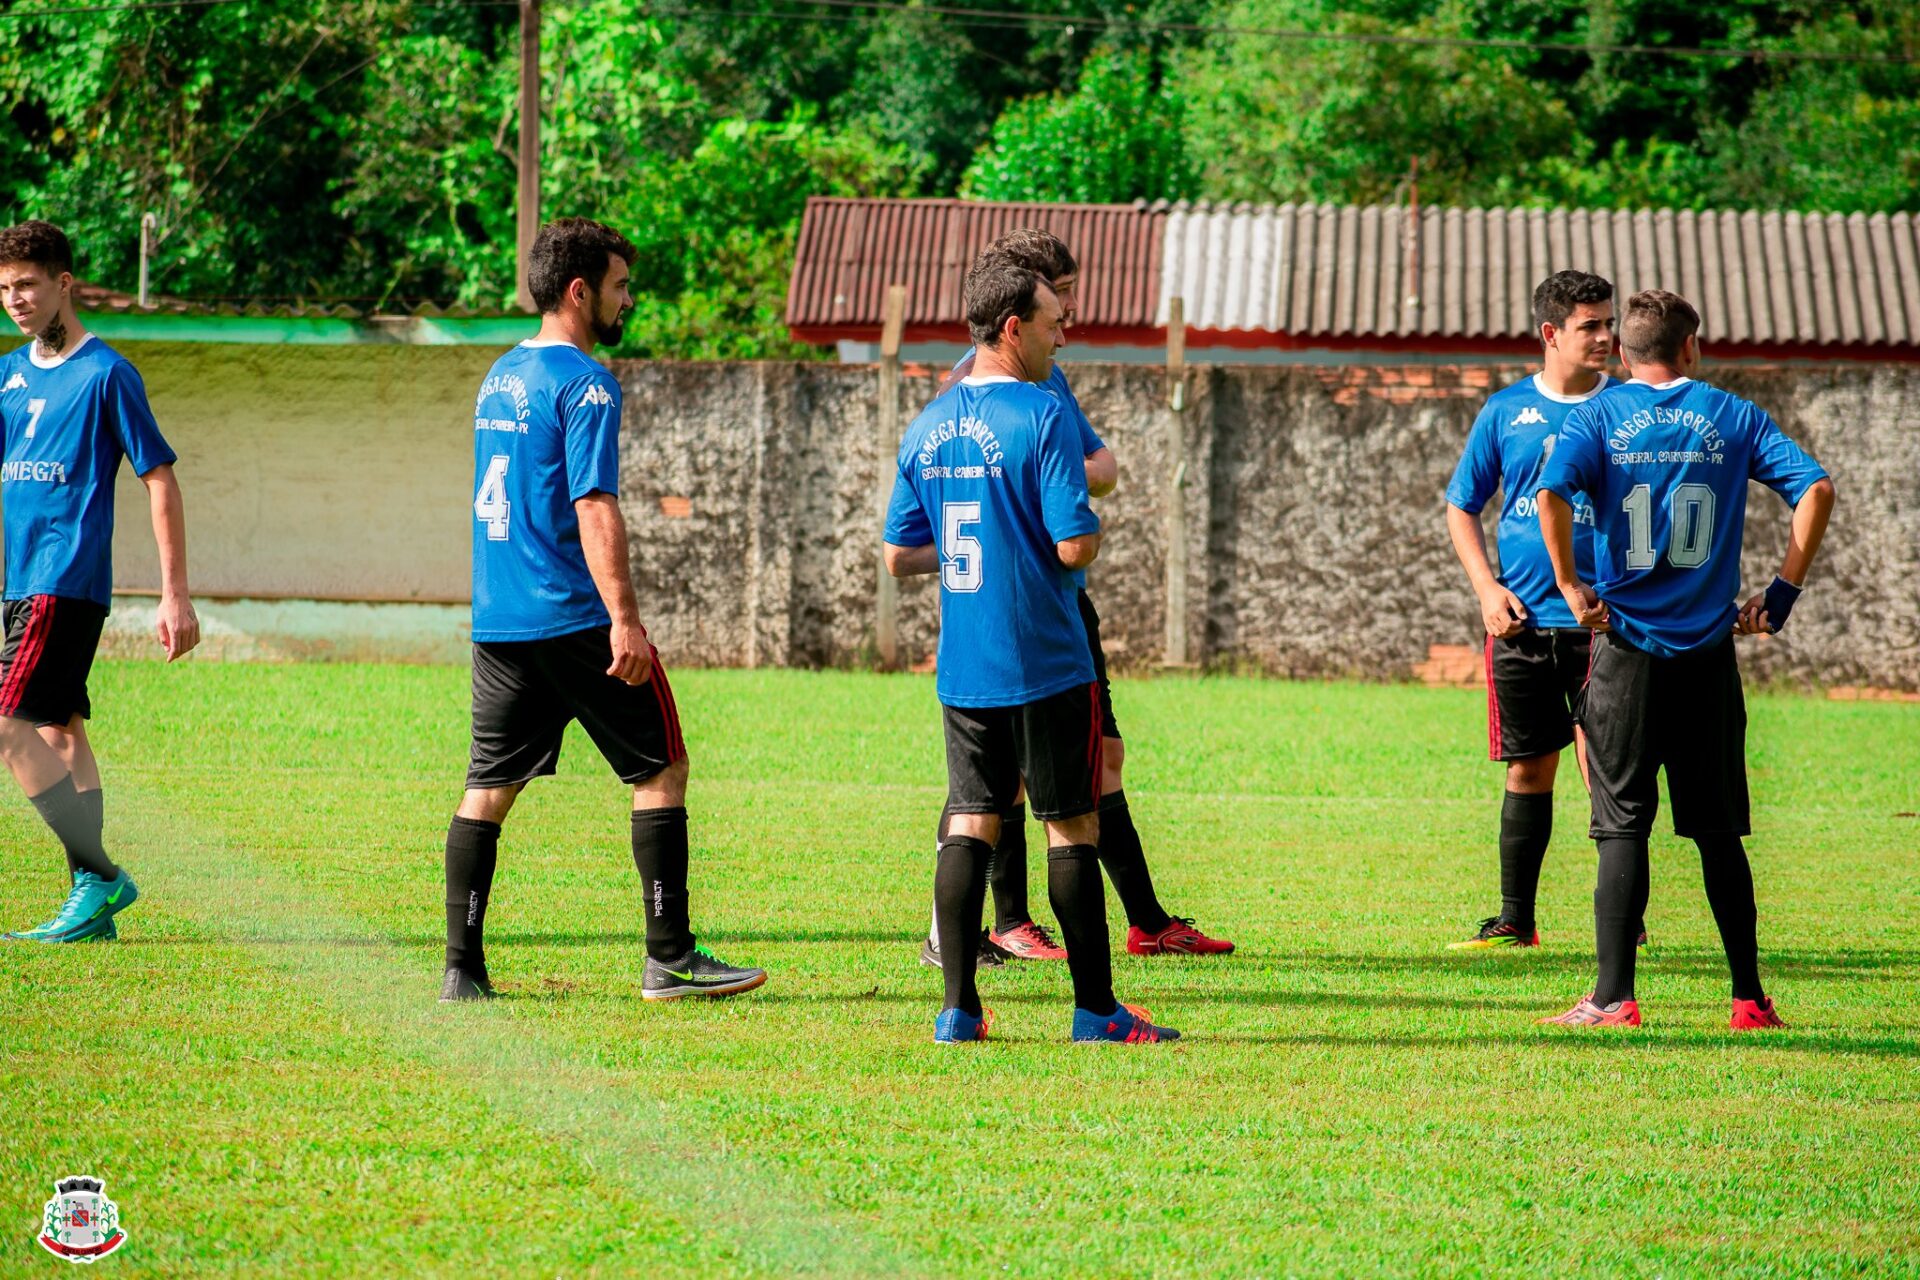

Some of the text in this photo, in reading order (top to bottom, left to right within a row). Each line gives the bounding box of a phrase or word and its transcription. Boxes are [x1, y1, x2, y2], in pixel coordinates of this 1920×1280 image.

[25, 398, 47, 439] 7
[1608, 406, 1725, 451] OMEGA ESPORTES
[918, 419, 957, 465] OMEGA
[1611, 452, 1656, 465] GENERAL
[1658, 451, 1705, 463] CARNEIRO
[1711, 453, 1724, 465] PR
[1, 461, 66, 483] OMEGA
[922, 466, 952, 480] GENRAL
[991, 466, 1002, 478] PR
[474, 455, 510, 541] 4
[942, 501, 983, 593] 5
[1622, 482, 1716, 571] 10
[467, 890, 479, 926] PENALTY
[653, 880, 663, 917] PENALTY
